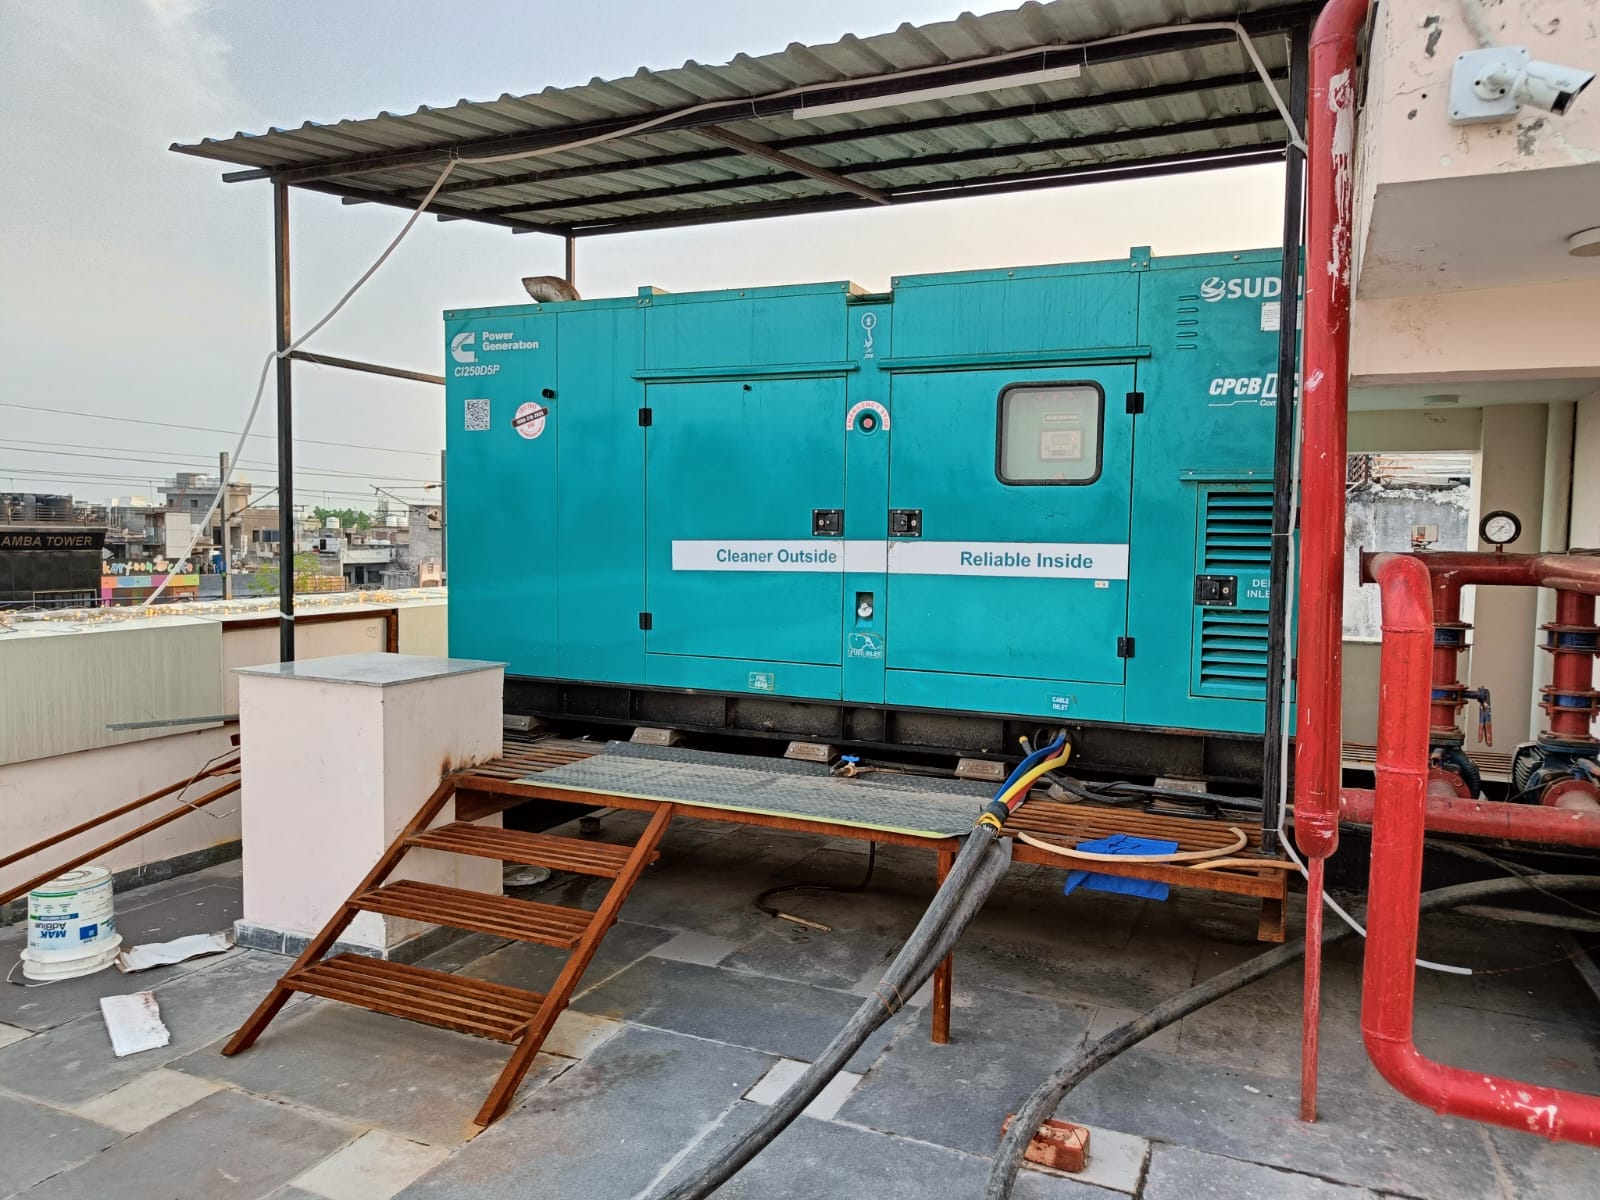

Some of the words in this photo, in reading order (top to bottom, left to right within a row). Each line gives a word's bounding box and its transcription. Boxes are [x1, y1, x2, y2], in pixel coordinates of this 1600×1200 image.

[482, 331, 514, 341] Power
[482, 341, 539, 351] Generation
[454, 364, 500, 377] CI250D5P
[1209, 377, 1262, 396] CPCB
[1, 536, 42, 547] AMBA
[46, 536, 93, 547] TOWER
[716, 548, 773, 563] Cleaner
[777, 548, 837, 563] Outside
[960, 551, 1031, 568] Reliable
[1037, 552, 1093, 569] Inside
[1252, 579, 1271, 588] DE
[1247, 590, 1271, 599] INLE
[1052, 696, 1070, 704] CABLE
[1052, 703, 1069, 711] INLET
[35, 922, 66, 931] AdBlue
[41, 931, 67, 939] MAK
